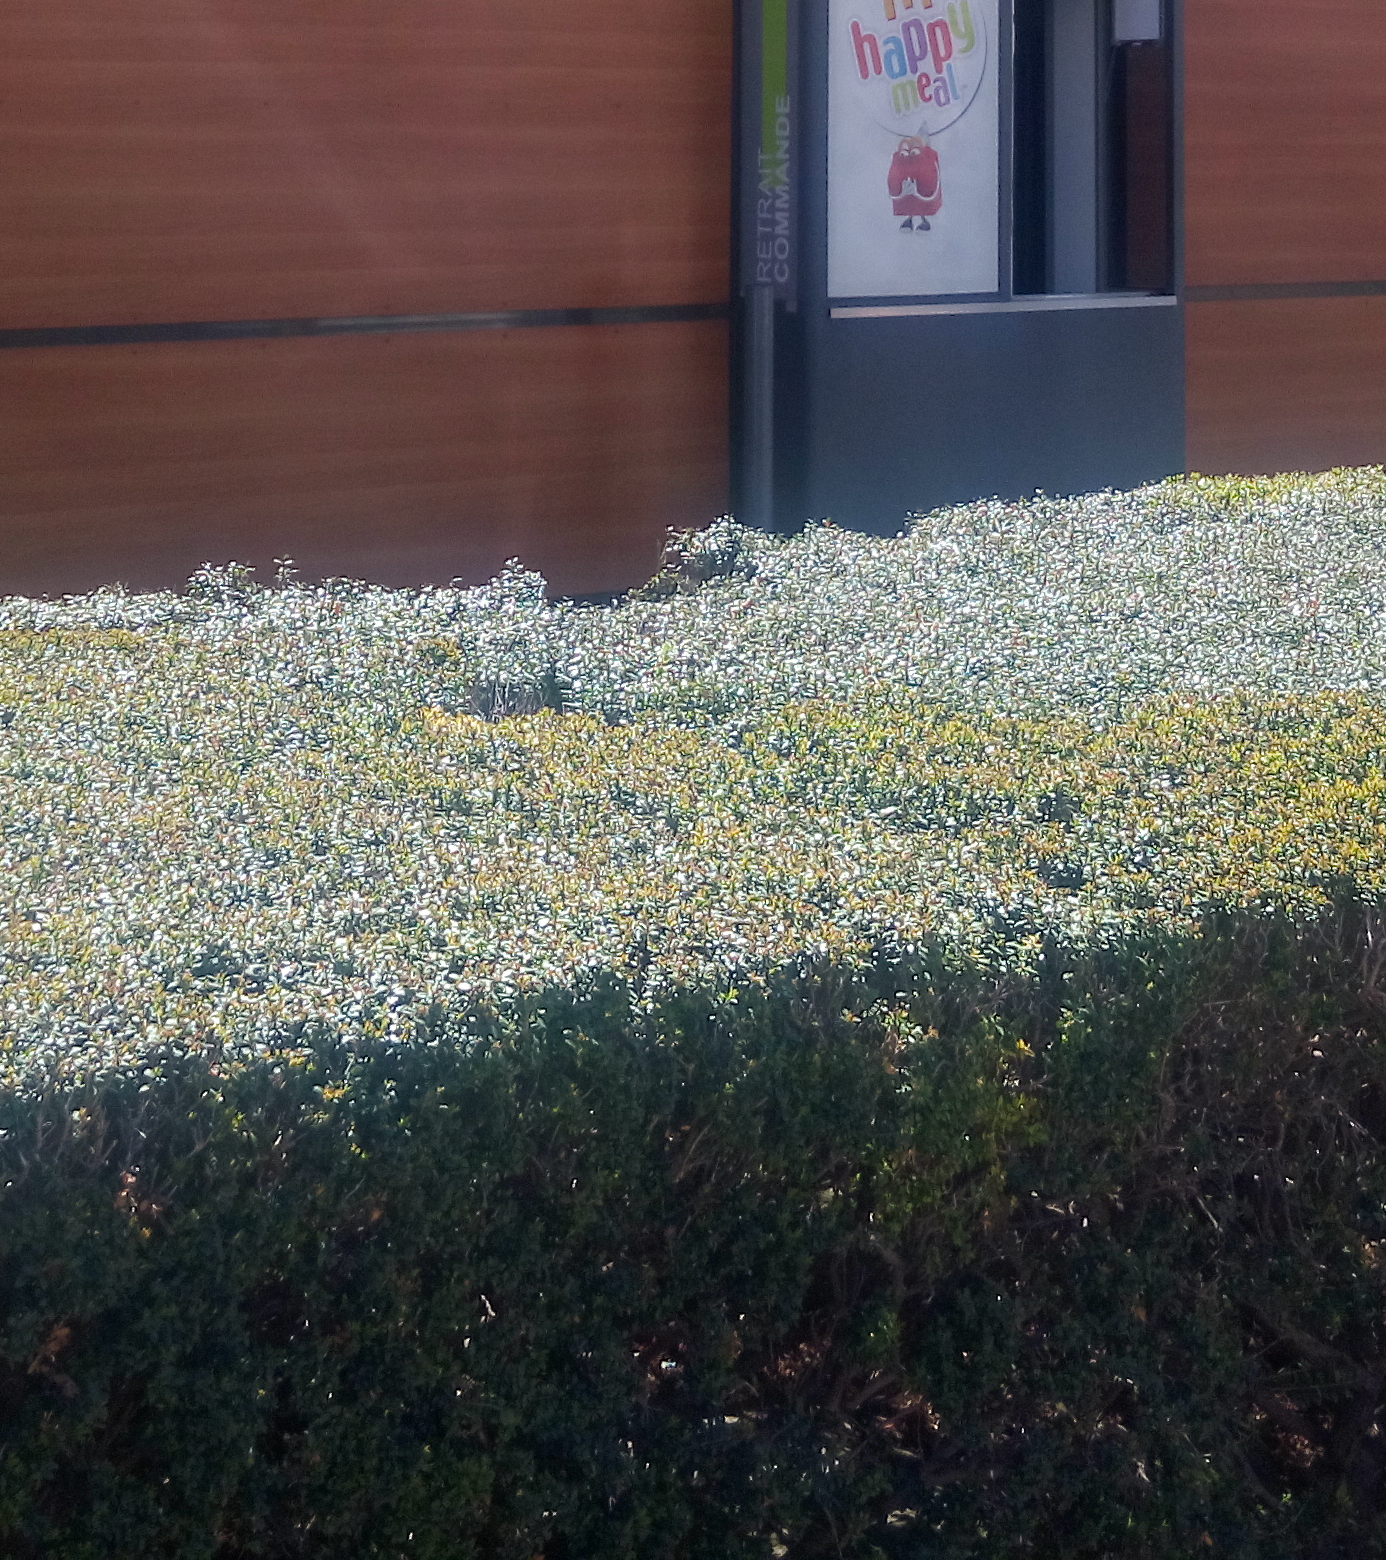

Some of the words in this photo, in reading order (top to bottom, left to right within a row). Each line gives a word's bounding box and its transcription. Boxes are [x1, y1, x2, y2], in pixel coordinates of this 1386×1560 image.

[890, 61, 959, 115] meal
[756, 146, 773, 284] RETRAIT
[773, 94, 790, 284] COMMANDE
